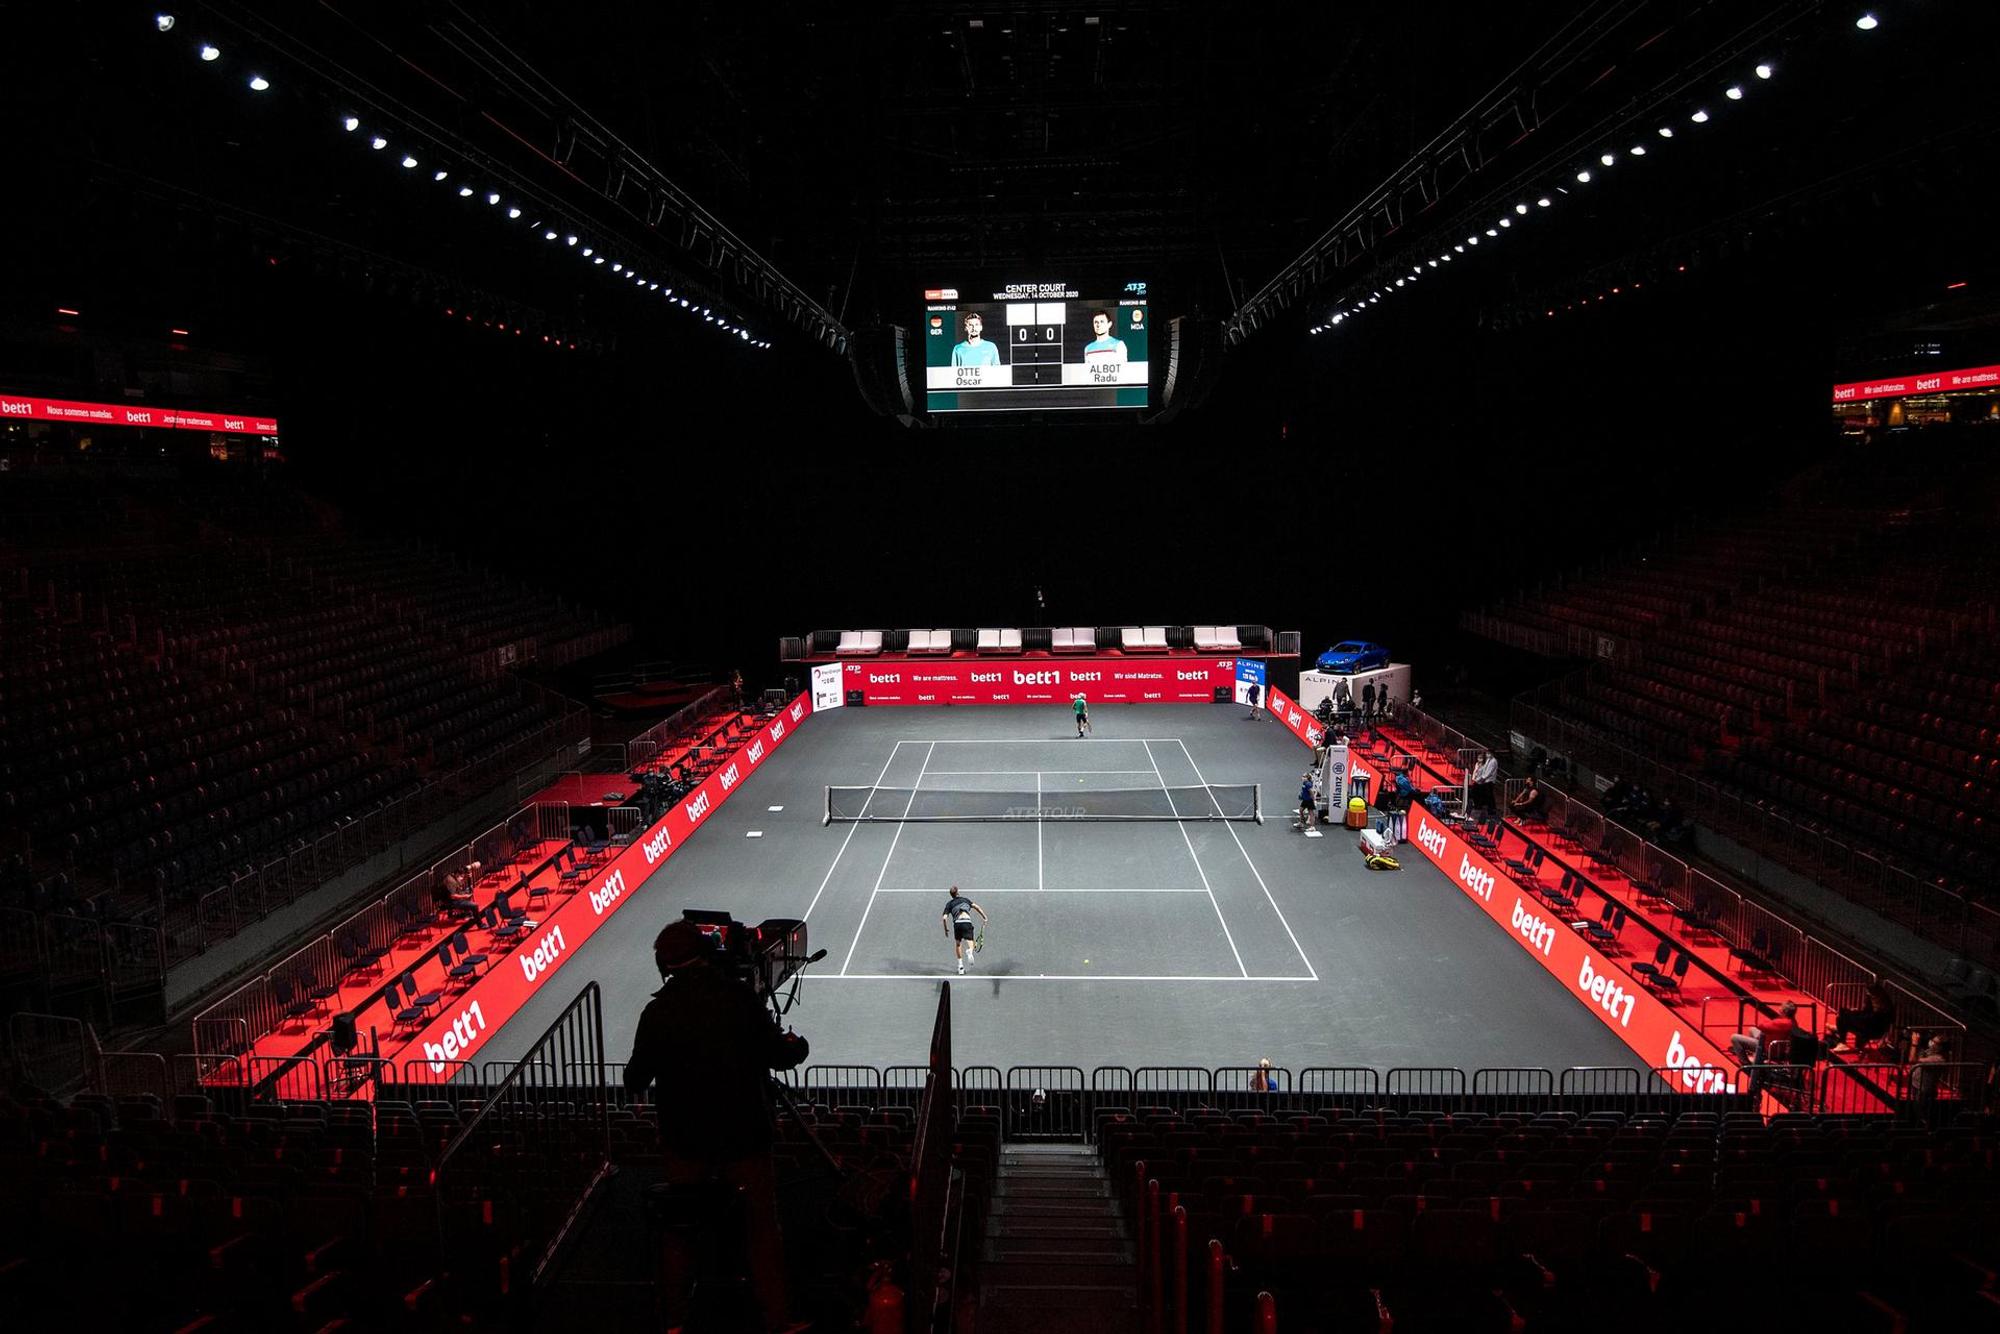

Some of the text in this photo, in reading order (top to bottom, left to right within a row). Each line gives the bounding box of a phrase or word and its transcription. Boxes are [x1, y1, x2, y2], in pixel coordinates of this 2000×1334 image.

[1005, 282, 1066, 293] CENTER COURT
[1123, 283, 1146, 291] ATP
[993, 292, 1031, 300] WEDNESDAY,
[1038, 290, 1065, 298] OCTOBER
[1065, 290, 1079, 298] 2020
[1019, 328, 1027, 341] 0
[1046, 327, 1054, 341] 0
[957, 367, 980, 377] OTTE
[1090, 364, 1121, 374] ALBOT
[956, 377, 982, 386] Oscar
[1094, 374, 1117, 383] Radu
[1917, 378, 1940, 390] bett1
[1952, 376, 1961, 384] We
[1962, 375, 1971, 383] are
[1834, 388, 1855, 399] bett1
[2, 401, 32, 414] bett1
[47, 405, 63, 415] Nous
[126, 411, 151, 423] bett1
[224, 418, 245, 430] bett1
[869, 673, 901, 683] bett1
[971, 672, 1001, 682] bett1
[1013, 670, 1060, 685] bett1
[1070, 671, 1101, 681] bett1
[1177, 670, 1209, 680] bett1
[1305, 676, 1339, 685] ALPIN
[790, 702, 804, 723] bett1
[1288, 706, 1302, 730] bett1
[769, 719, 785, 742] bett1
[746, 739, 764, 764] bett1
[719, 762, 740, 791] bett1
[1333, 776, 1343, 808] Allianz
[685, 790, 710, 822] bett1
[1043, 806, 1087, 820] TOUR
[1418, 817, 1447, 859] bett1
[642, 826, 672, 864] bett1
[1459, 853, 1495, 901] bett1
[588, 868, 626, 915] bett1
[1511, 897, 1556, 957] bett1
[519, 925, 567, 982] bett1
[1578, 955, 1636, 1027] bett1
[423, 1000, 486, 1074] bett1
[1666, 1030, 1737, 1094] bett
